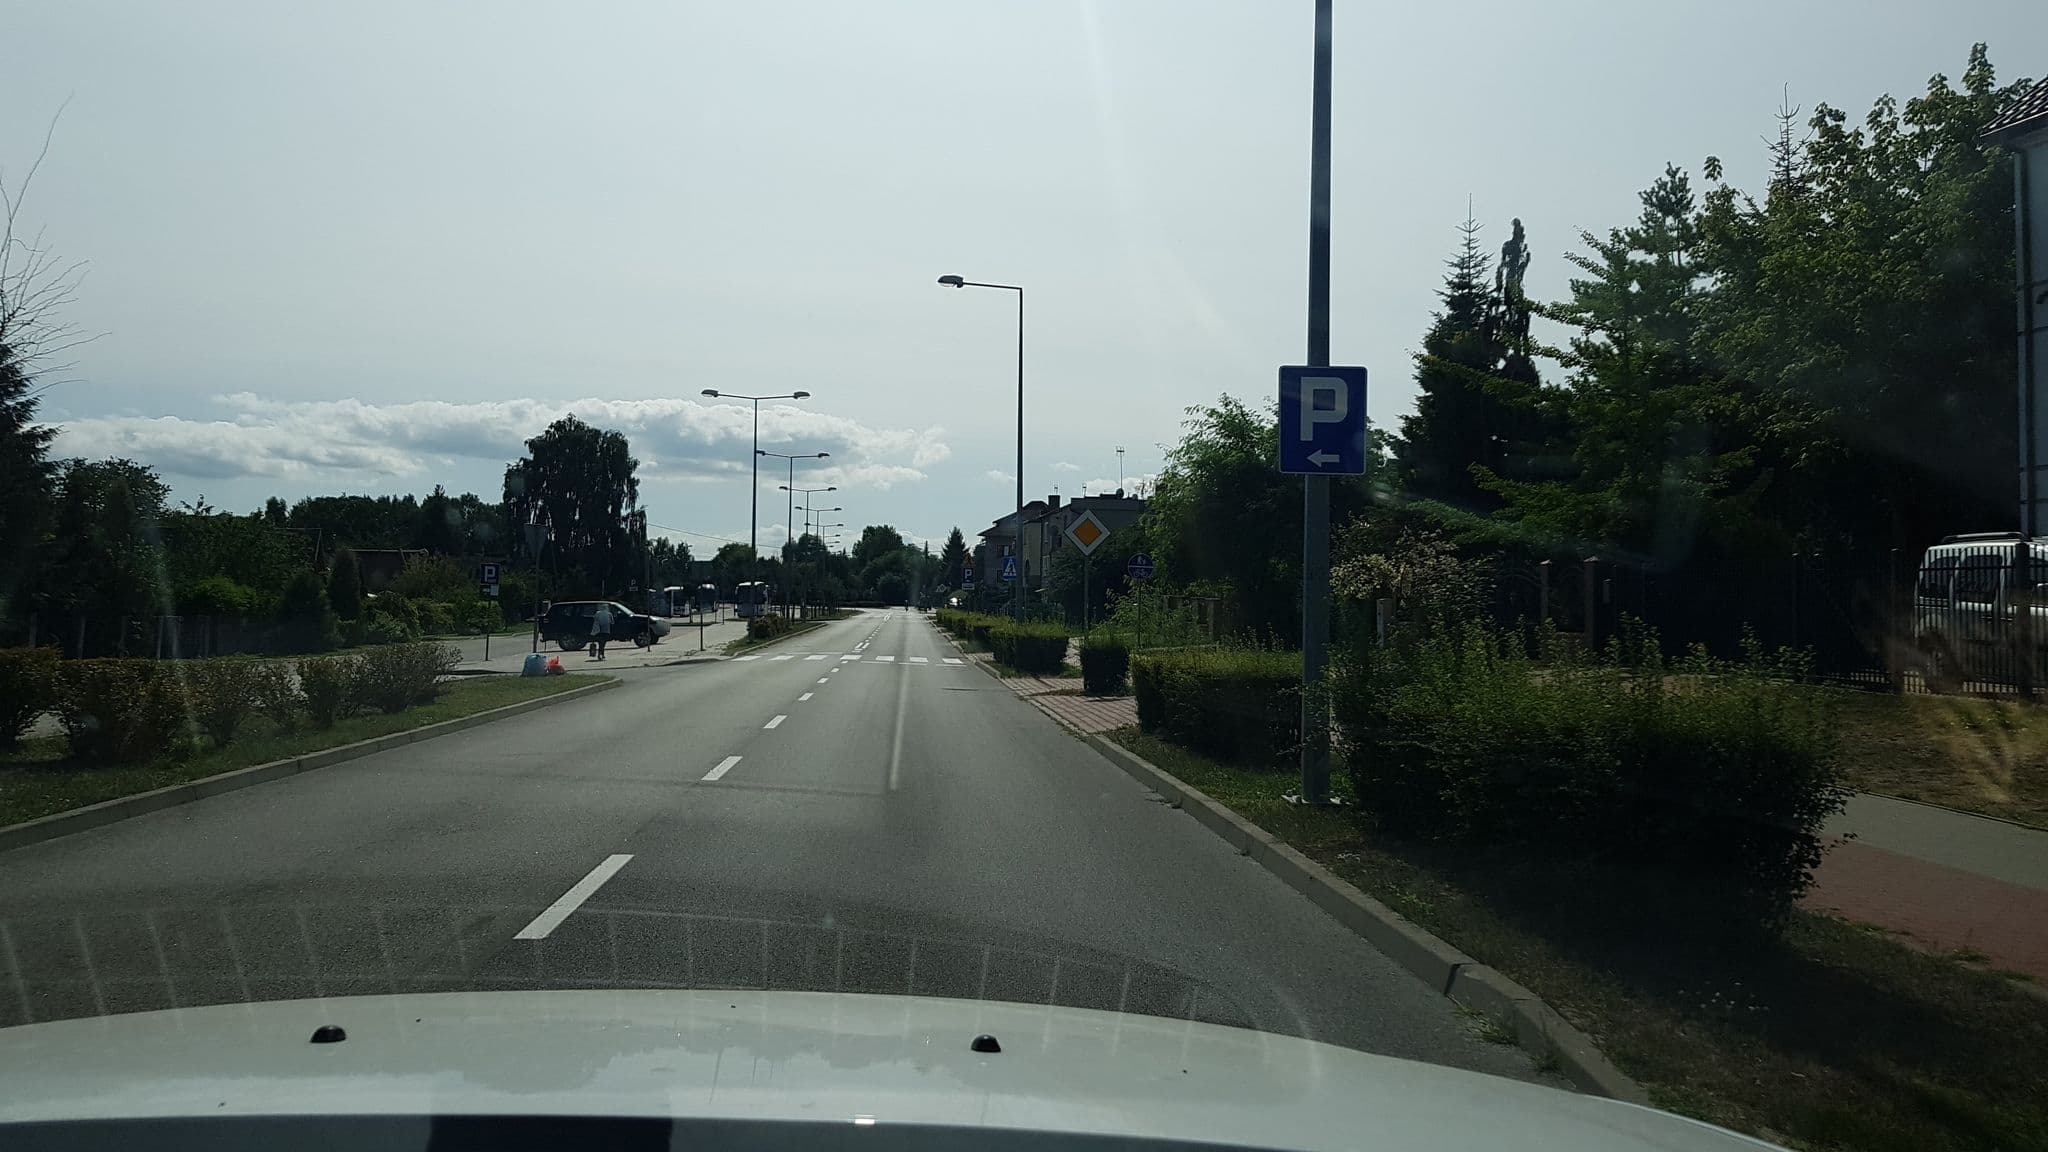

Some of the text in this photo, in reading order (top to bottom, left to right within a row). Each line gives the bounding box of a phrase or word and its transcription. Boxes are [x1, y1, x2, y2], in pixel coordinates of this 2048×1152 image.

[1300, 376, 1348, 441] P
[484, 565, 496, 582] P
[964, 568, 973, 579] P
